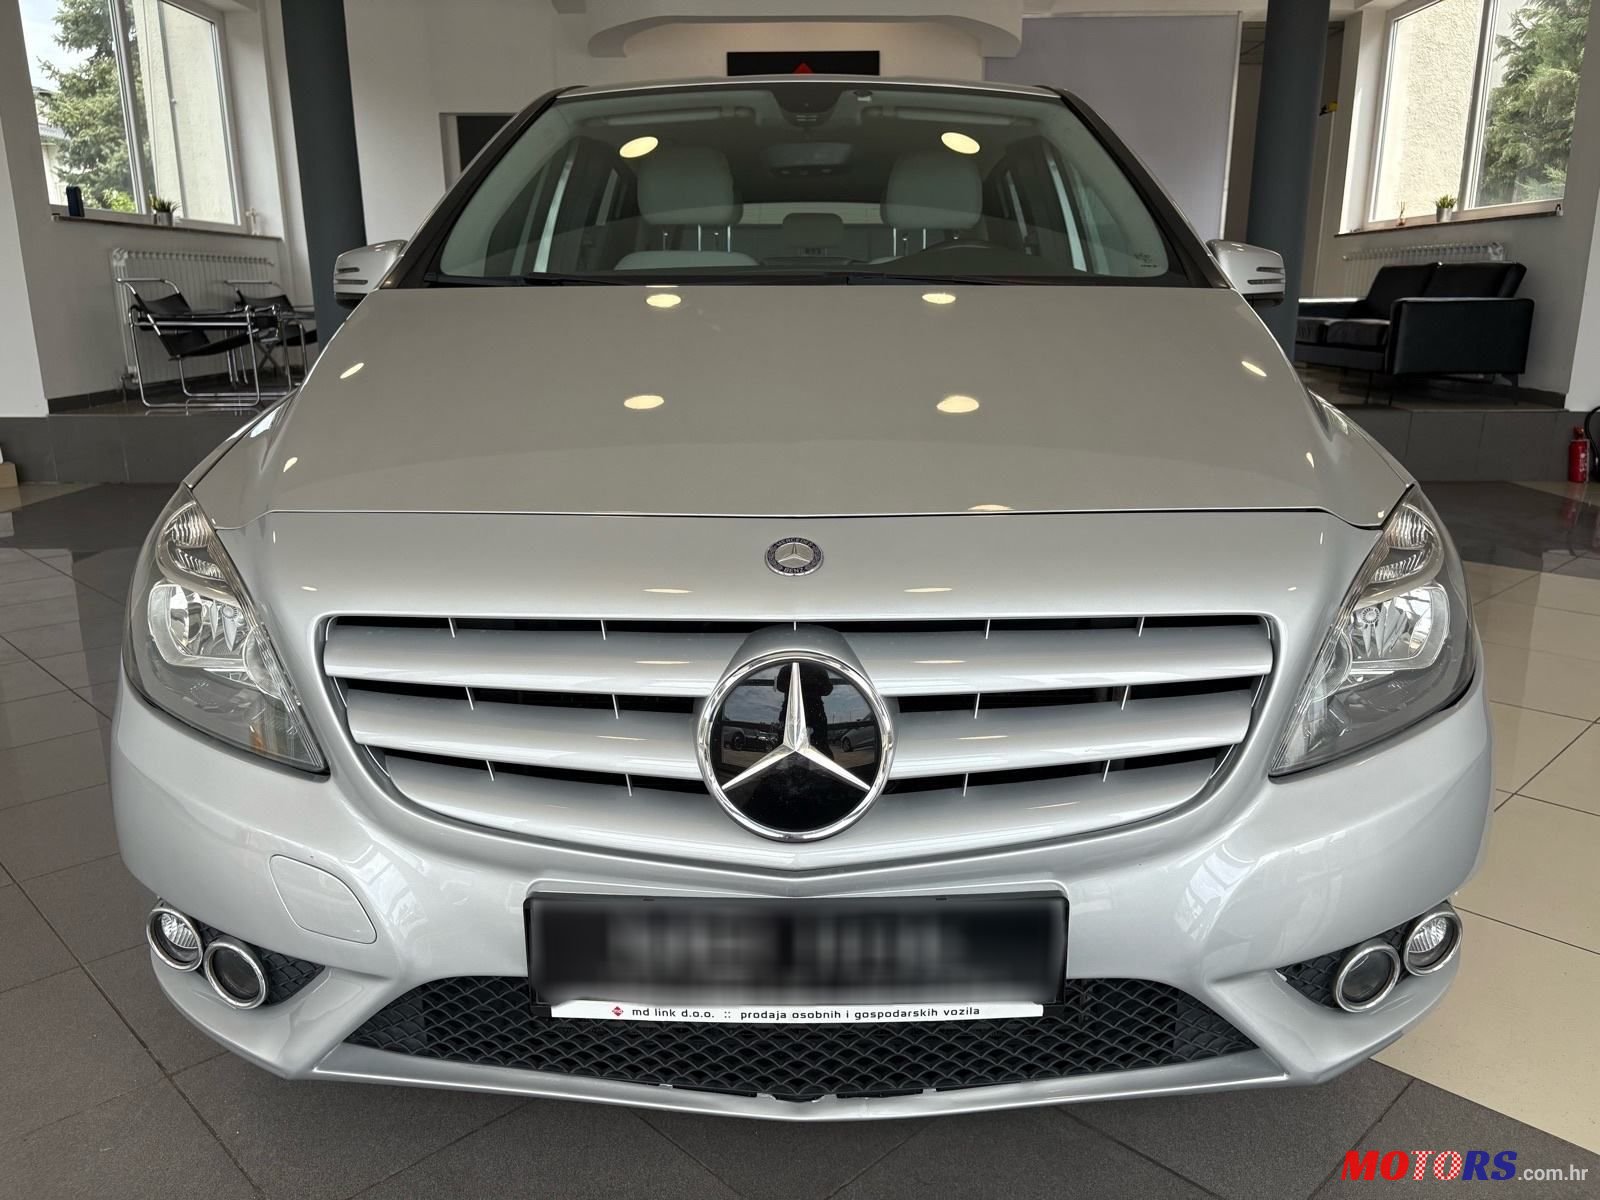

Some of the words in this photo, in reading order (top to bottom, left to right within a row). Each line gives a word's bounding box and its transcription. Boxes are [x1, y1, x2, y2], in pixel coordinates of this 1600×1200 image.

[632, 1008, 650, 1016] md
[655, 1008, 676, 1017] link
[681, 1009, 715, 1018] d.o.o.
[740, 1010, 787, 1020] prodaja
[792, 1010, 841, 1019] osobnih
[846, 1009, 849, 1019] i
[854, 1008, 938, 1020] gospodarskih
[943, 1007, 980, 1016] vozila
